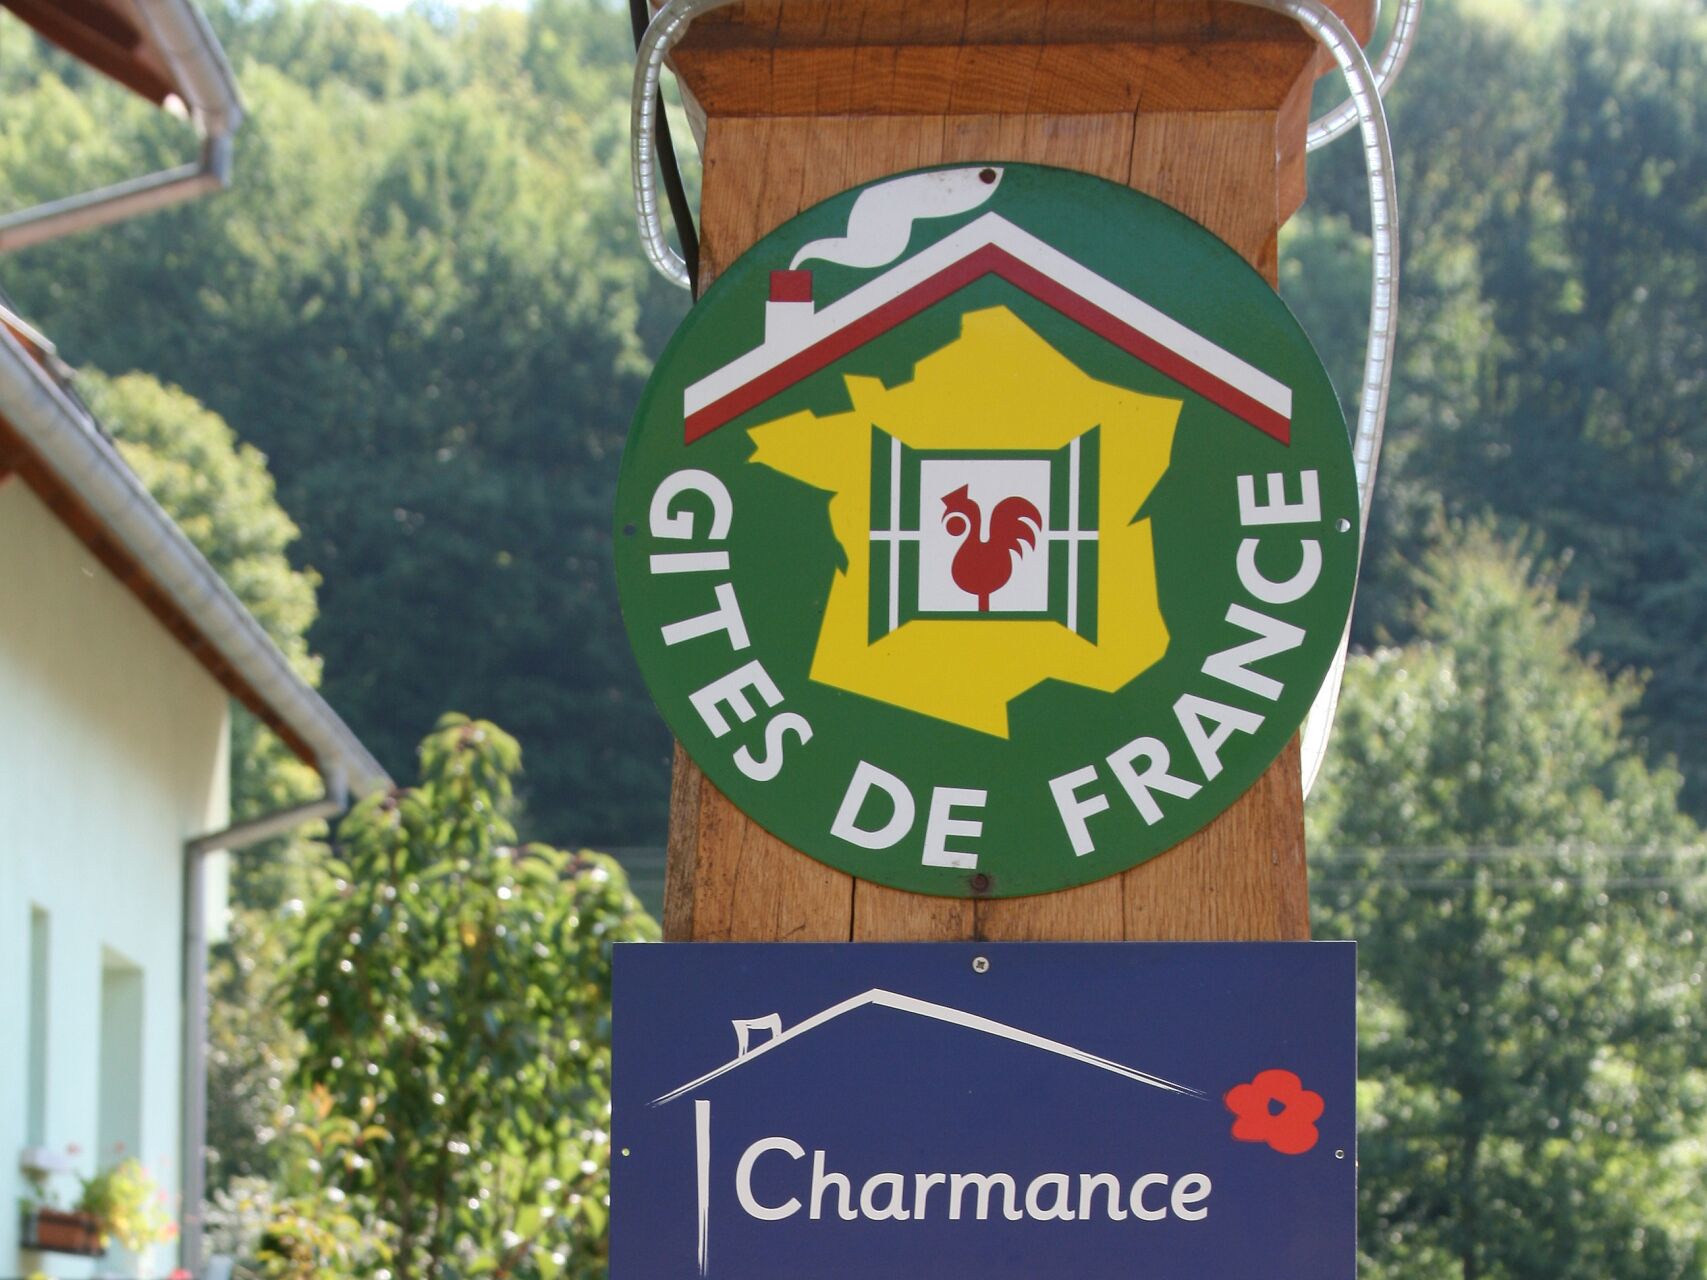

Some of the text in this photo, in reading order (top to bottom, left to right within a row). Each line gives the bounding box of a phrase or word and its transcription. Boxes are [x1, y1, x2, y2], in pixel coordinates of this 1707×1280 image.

[649, 469, 1322, 869] GITES DE FRANCE
[735, 1137, 1212, 1222] Charmance
